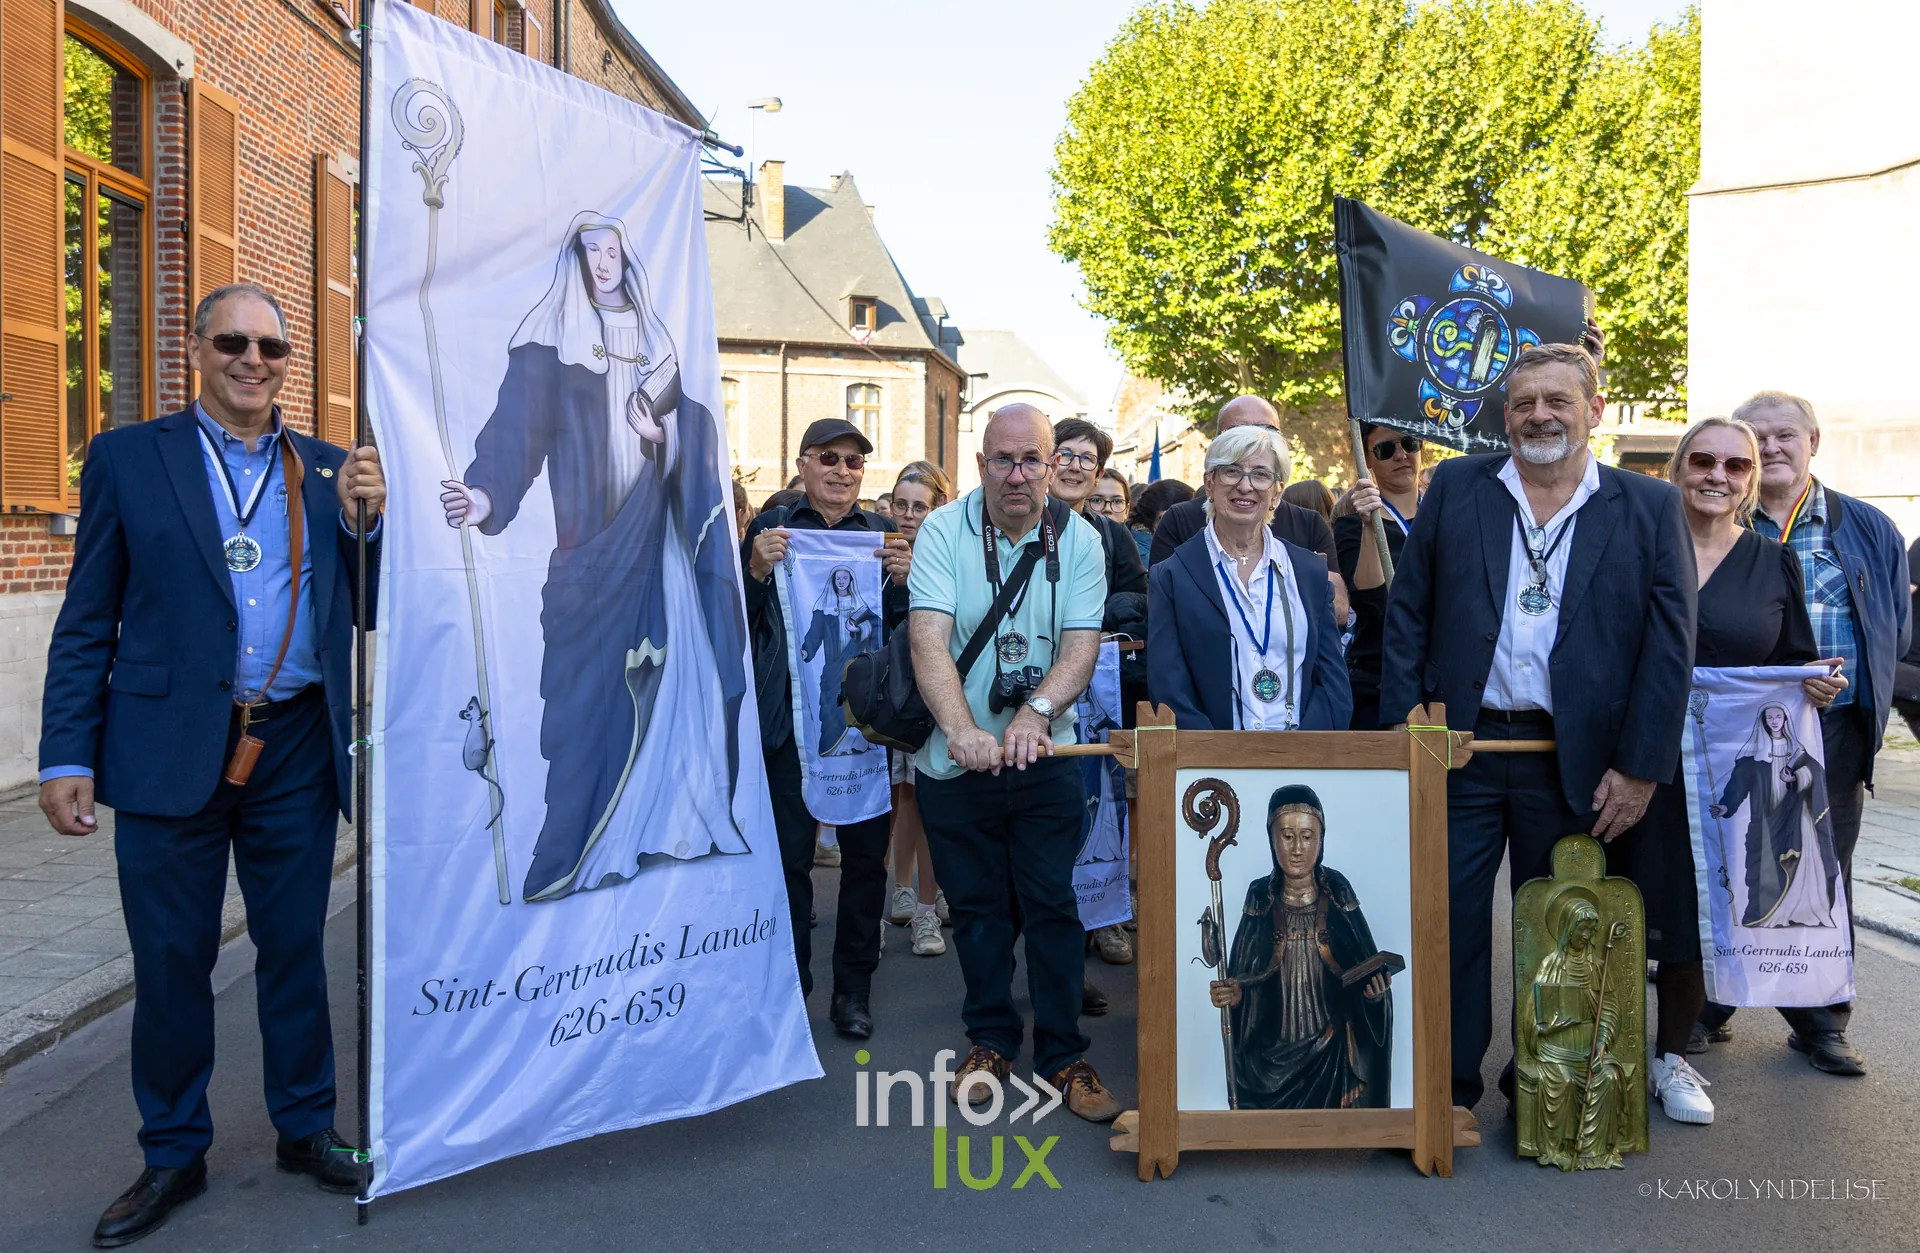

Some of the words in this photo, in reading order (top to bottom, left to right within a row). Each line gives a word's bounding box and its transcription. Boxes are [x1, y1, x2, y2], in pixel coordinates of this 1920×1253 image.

[1046, 525, 1053, 534] R7
[985, 525, 993, 552] Canon
[1048, 534, 1056, 552] EOS
[826, 784, 862, 796] 626-659
[1076, 891, 1106, 905] 26-659
[1714, 944, 1801, 957] Sint-Gertrudis
[1804, 945, 1853, 958] Landen
[412, 933, 666, 1017] Sint-Gertrudis
[674, 908, 777, 961] Landen
[1758, 961, 1808, 975] 626-659
[549, 982, 687, 1047] 626-659
